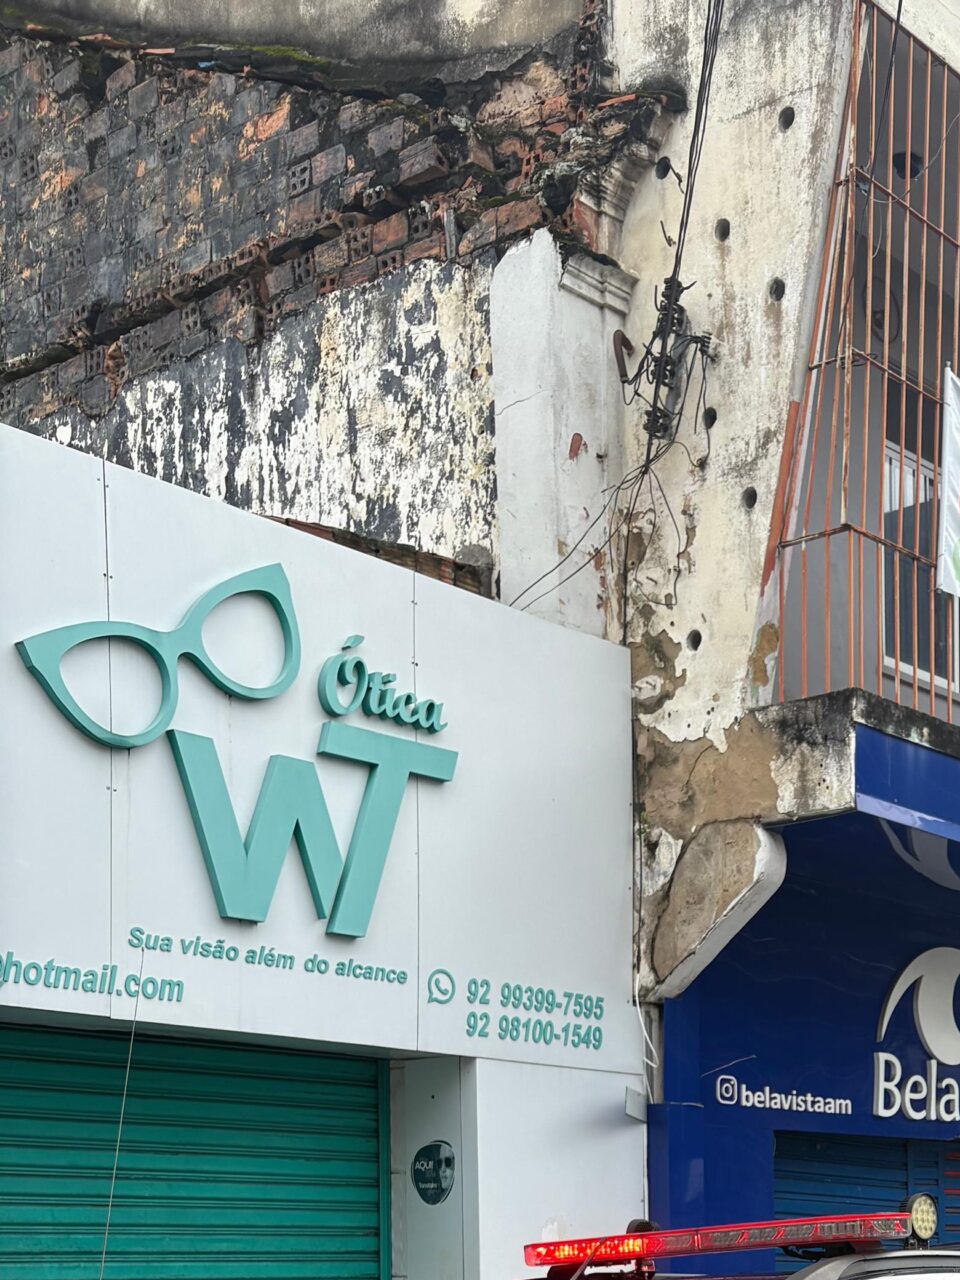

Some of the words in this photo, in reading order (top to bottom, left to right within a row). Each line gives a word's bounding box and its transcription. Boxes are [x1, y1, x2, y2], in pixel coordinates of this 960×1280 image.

[317, 634, 448, 734] Ótica
[167, 721, 458, 940] WT
[0, 950, 185, 1002] hotmail.com
[127, 927, 173, 953] Sua
[181, 935, 239, 962] visão
[245, 945, 295, 970] além
[304, 954, 330, 974] do
[334, 958, 408, 985] alcance
[466, 977, 492, 1005] 92
[499, 983, 604, 1021] 99399-7595
[465, 1011, 490, 1038] 92
[498, 1015, 603, 1050] 98100-1549
[741, 1084, 852, 1115] belavistaam
[873, 1052, 960, 1122] Bela
